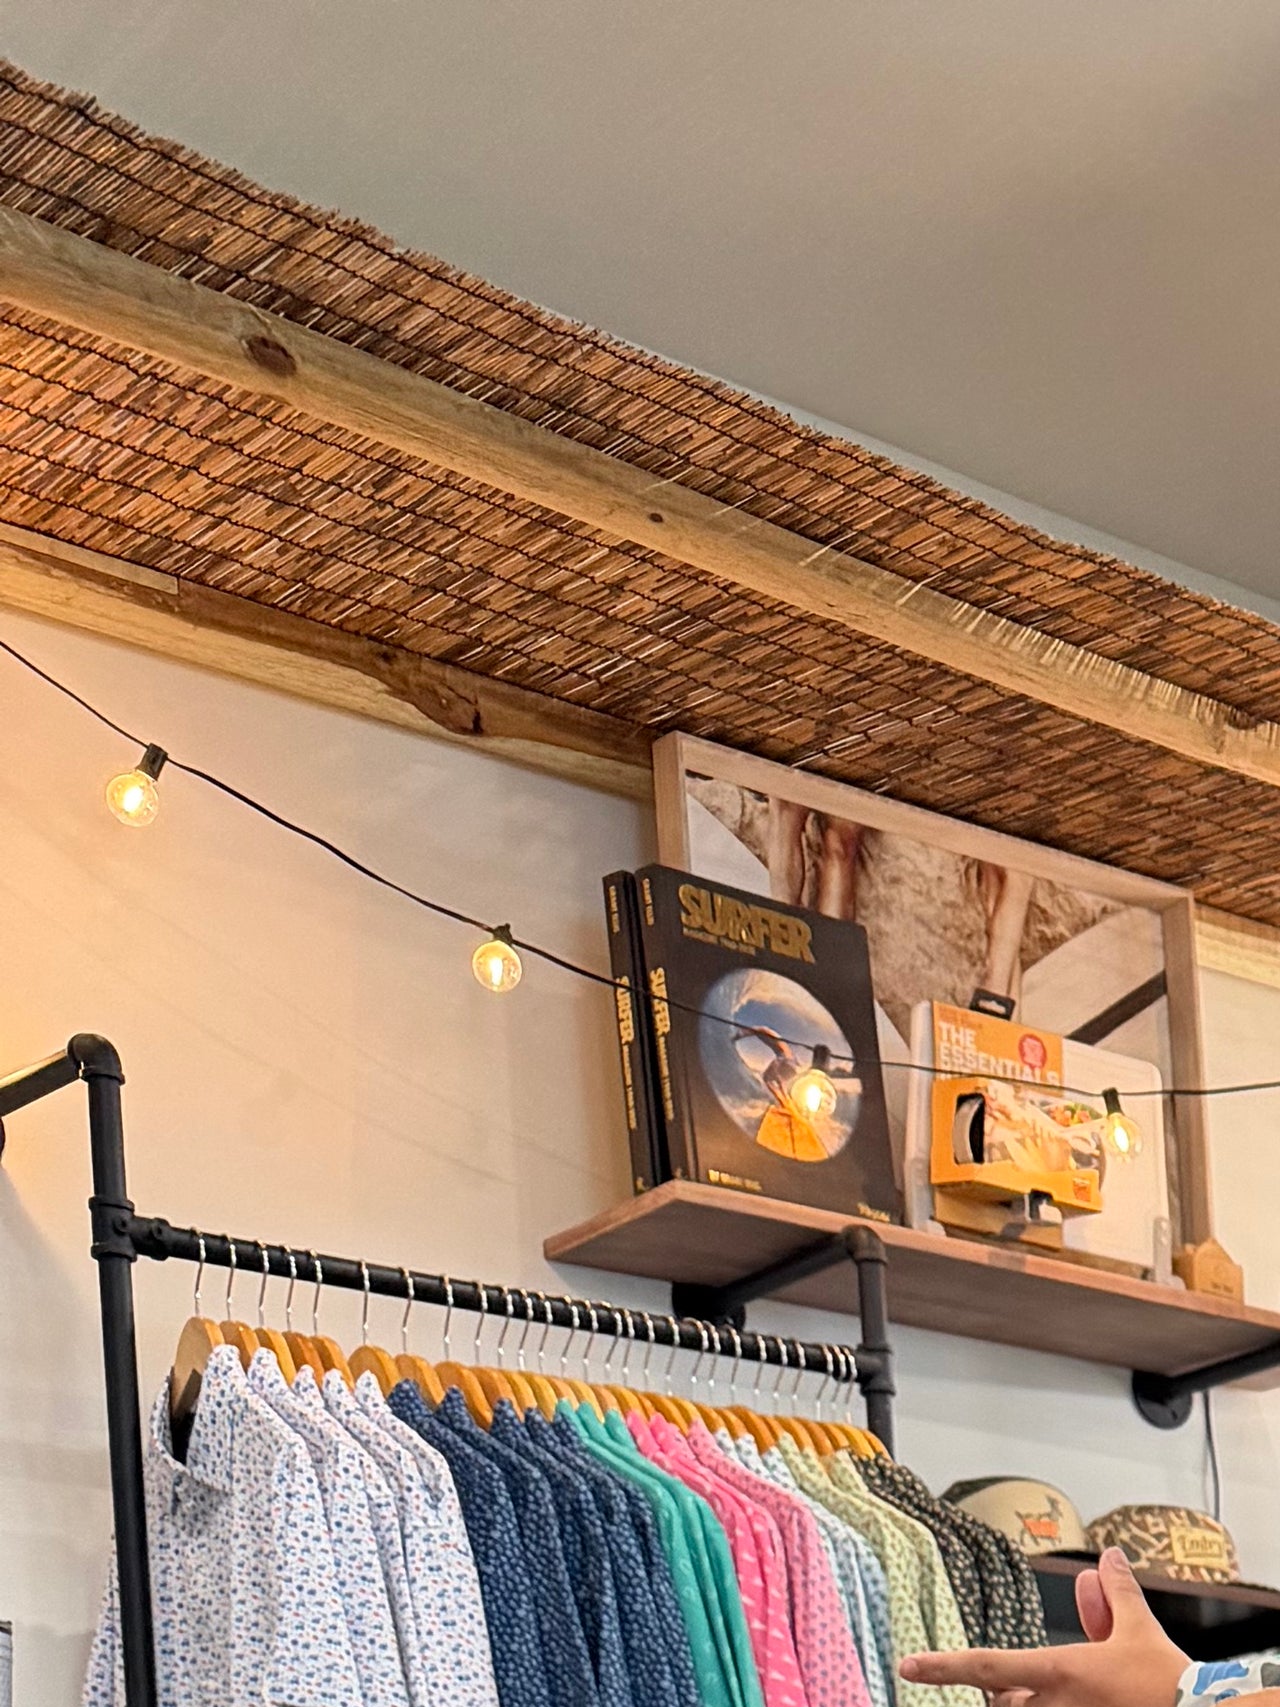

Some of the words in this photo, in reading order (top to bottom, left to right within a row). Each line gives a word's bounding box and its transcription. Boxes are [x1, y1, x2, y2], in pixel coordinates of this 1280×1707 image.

[679, 883, 816, 964] SURFER
[614, 975, 634, 1045] SURFER
[649, 966, 672, 1036] SURFER
[938, 1021, 977, 1046] THE
[939, 1043, 1061, 1086] ESSENTIALS
